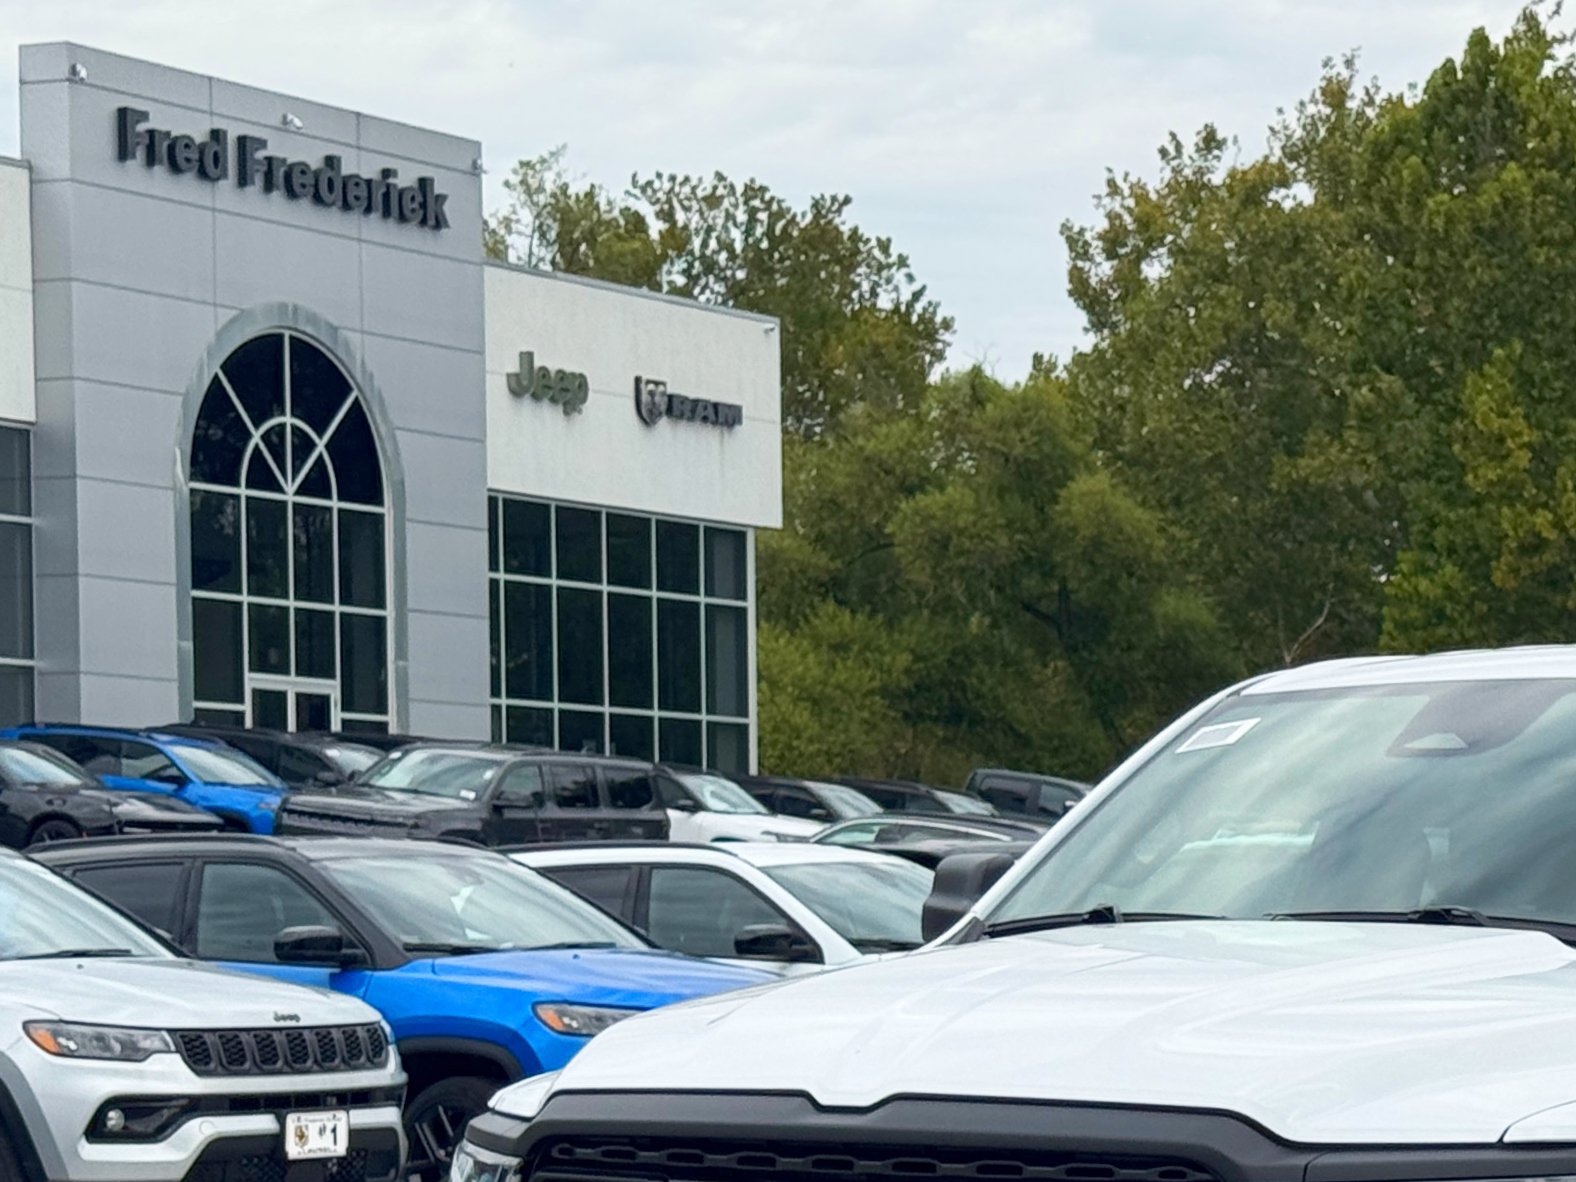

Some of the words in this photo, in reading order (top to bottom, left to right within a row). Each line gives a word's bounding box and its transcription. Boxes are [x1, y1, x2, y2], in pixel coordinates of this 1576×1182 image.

[117, 106, 228, 182] Fred
[237, 134, 450, 231] Frederick
[506, 350, 589, 416] Jeep
[666, 393, 743, 427] RAM
